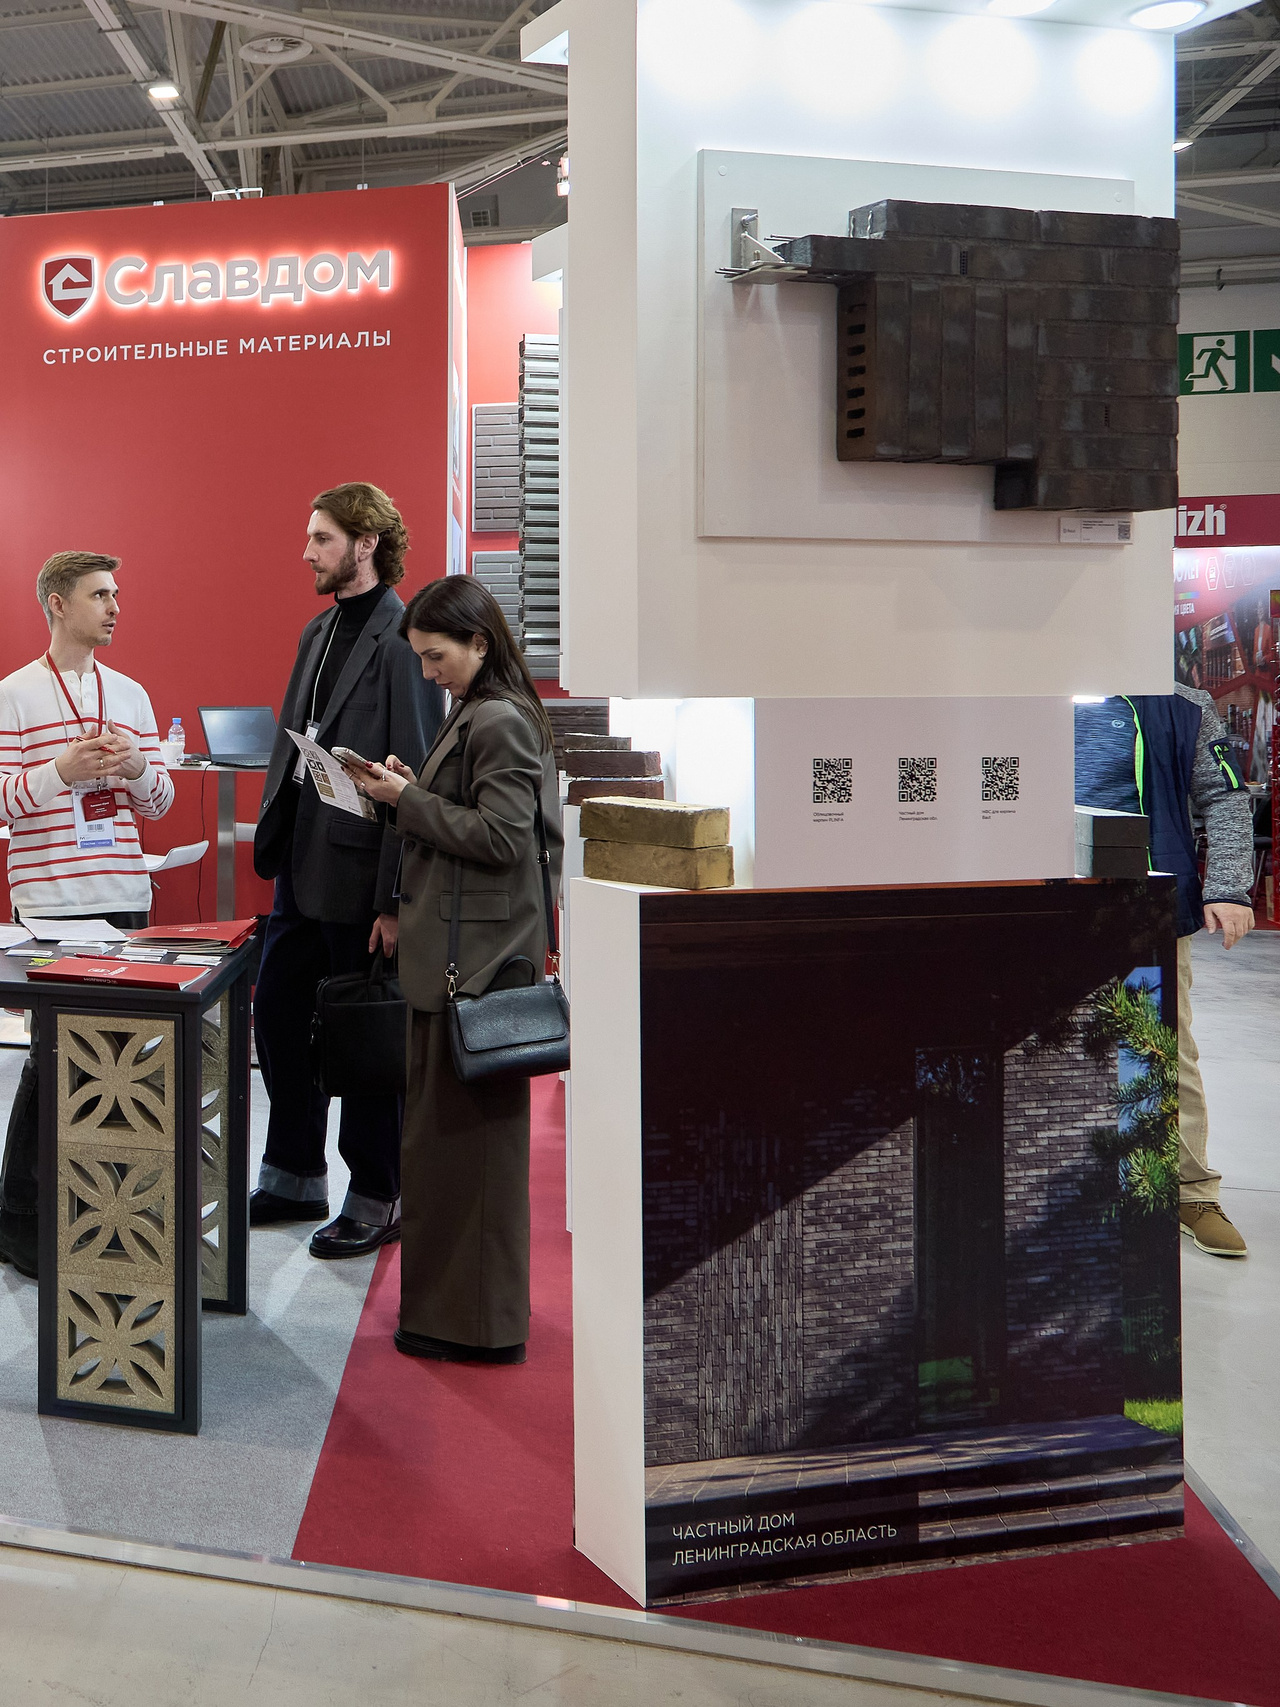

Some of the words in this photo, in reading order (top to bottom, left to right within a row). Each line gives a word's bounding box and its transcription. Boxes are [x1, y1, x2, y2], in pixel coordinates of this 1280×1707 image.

[104, 249, 393, 306] Славдом
[42, 339, 229, 365] СТРОИТЕЛЬНЫЕ
[238, 330, 392, 355] МАТЕРИАЛЫ
[1174, 504, 1226, 536] izh
[672, 1514, 754, 1540] ЧАСТНЫЙ
[758, 1512, 795, 1533] ДОМ
[671, 1534, 817, 1566] ЛЕНИНГРАДСКАЯ
[821, 1524, 898, 1546] ОБЛАСТЬ
